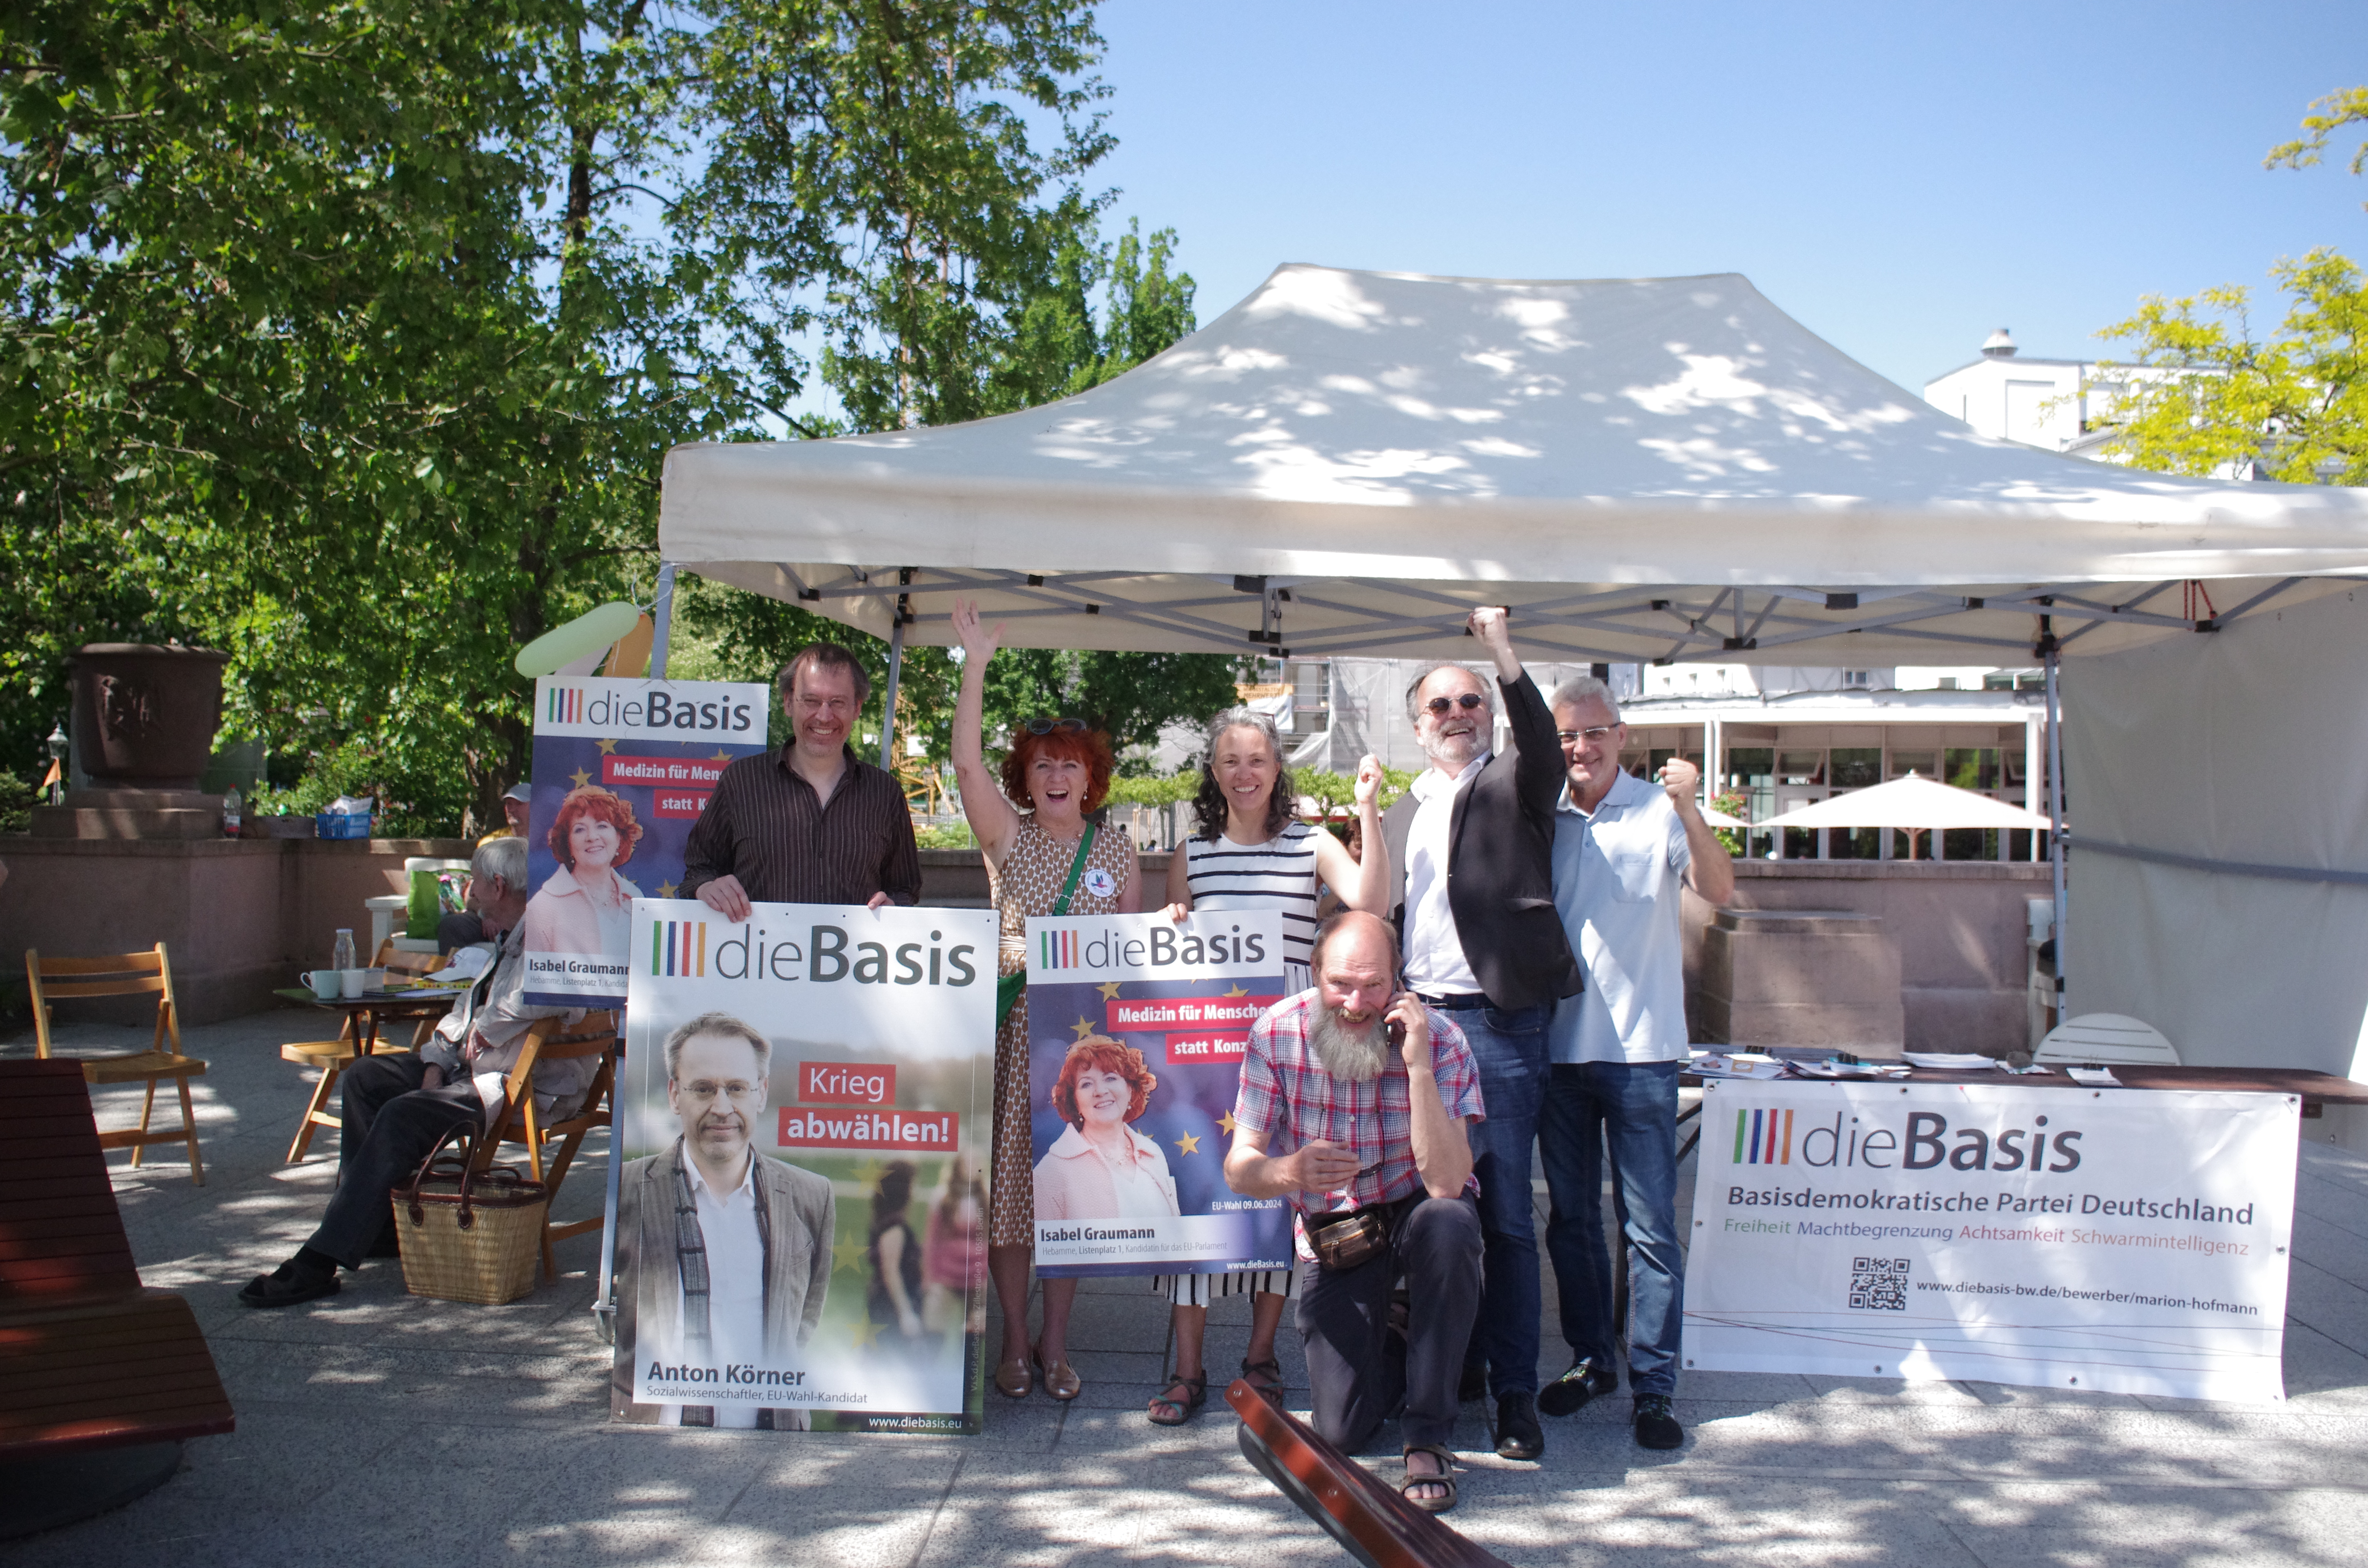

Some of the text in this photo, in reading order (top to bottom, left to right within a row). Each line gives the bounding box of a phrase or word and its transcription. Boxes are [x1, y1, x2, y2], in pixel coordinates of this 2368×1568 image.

[589, 690, 751, 731] dieBasis
[613, 762, 665, 778] Medizin
[668, 765, 689, 779] für
[662, 798, 692, 810] statt
[715, 924, 975, 987] dieBasis
[1085, 925, 1265, 967] dieBasis
[530, 959, 566, 972] Isabel
[530, 977, 561, 985] Hebamme,
[563, 978, 596, 987] Listenplatz
[1118, 1003, 1269, 1023] Medizin für Mensche
[1175, 1039, 1246, 1054] statt Konz
[810, 1067, 885, 1103] Krieg
[787, 1112, 949, 1143] abwählen!
[1802, 1111, 2083, 1173] dieBasis
[1212, 1200, 1282, 1210] EU-Wahl 09.06.2024
[1728, 1187, 2254, 1225] Basisdemokratische Partei Deutschland
[1041, 1227, 1155, 1241] Isabel Graumann
[1724, 1219, 2248, 1256] Freiheit Machtbegrenzung Achtsamkeit Schwarmintelligenz
[1043, 1247, 1077, 1255] Hebamme,
[1079, 1245, 1116, 1255] Listenplatz
[1125, 1243, 1159, 1252] Kandidatin
[1160, 1243, 1169, 1251] für
[1171, 1243, 1182, 1251] das
[1183, 1242, 1227, 1251] EU-Parlament
[1227, 1260, 1284, 1269] www.dieBasis.eu
[1917, 1281, 2258, 1315] www.diebasis-bw.de/bewerber/marion-hofmann
[647, 1361, 805, 1385] Anton Körner
[647, 1385, 867, 1404] Sozialwissenschaftler, EU-Wahl-Kandidat
[869, 1415, 962, 1429] www.diebasis.eu
